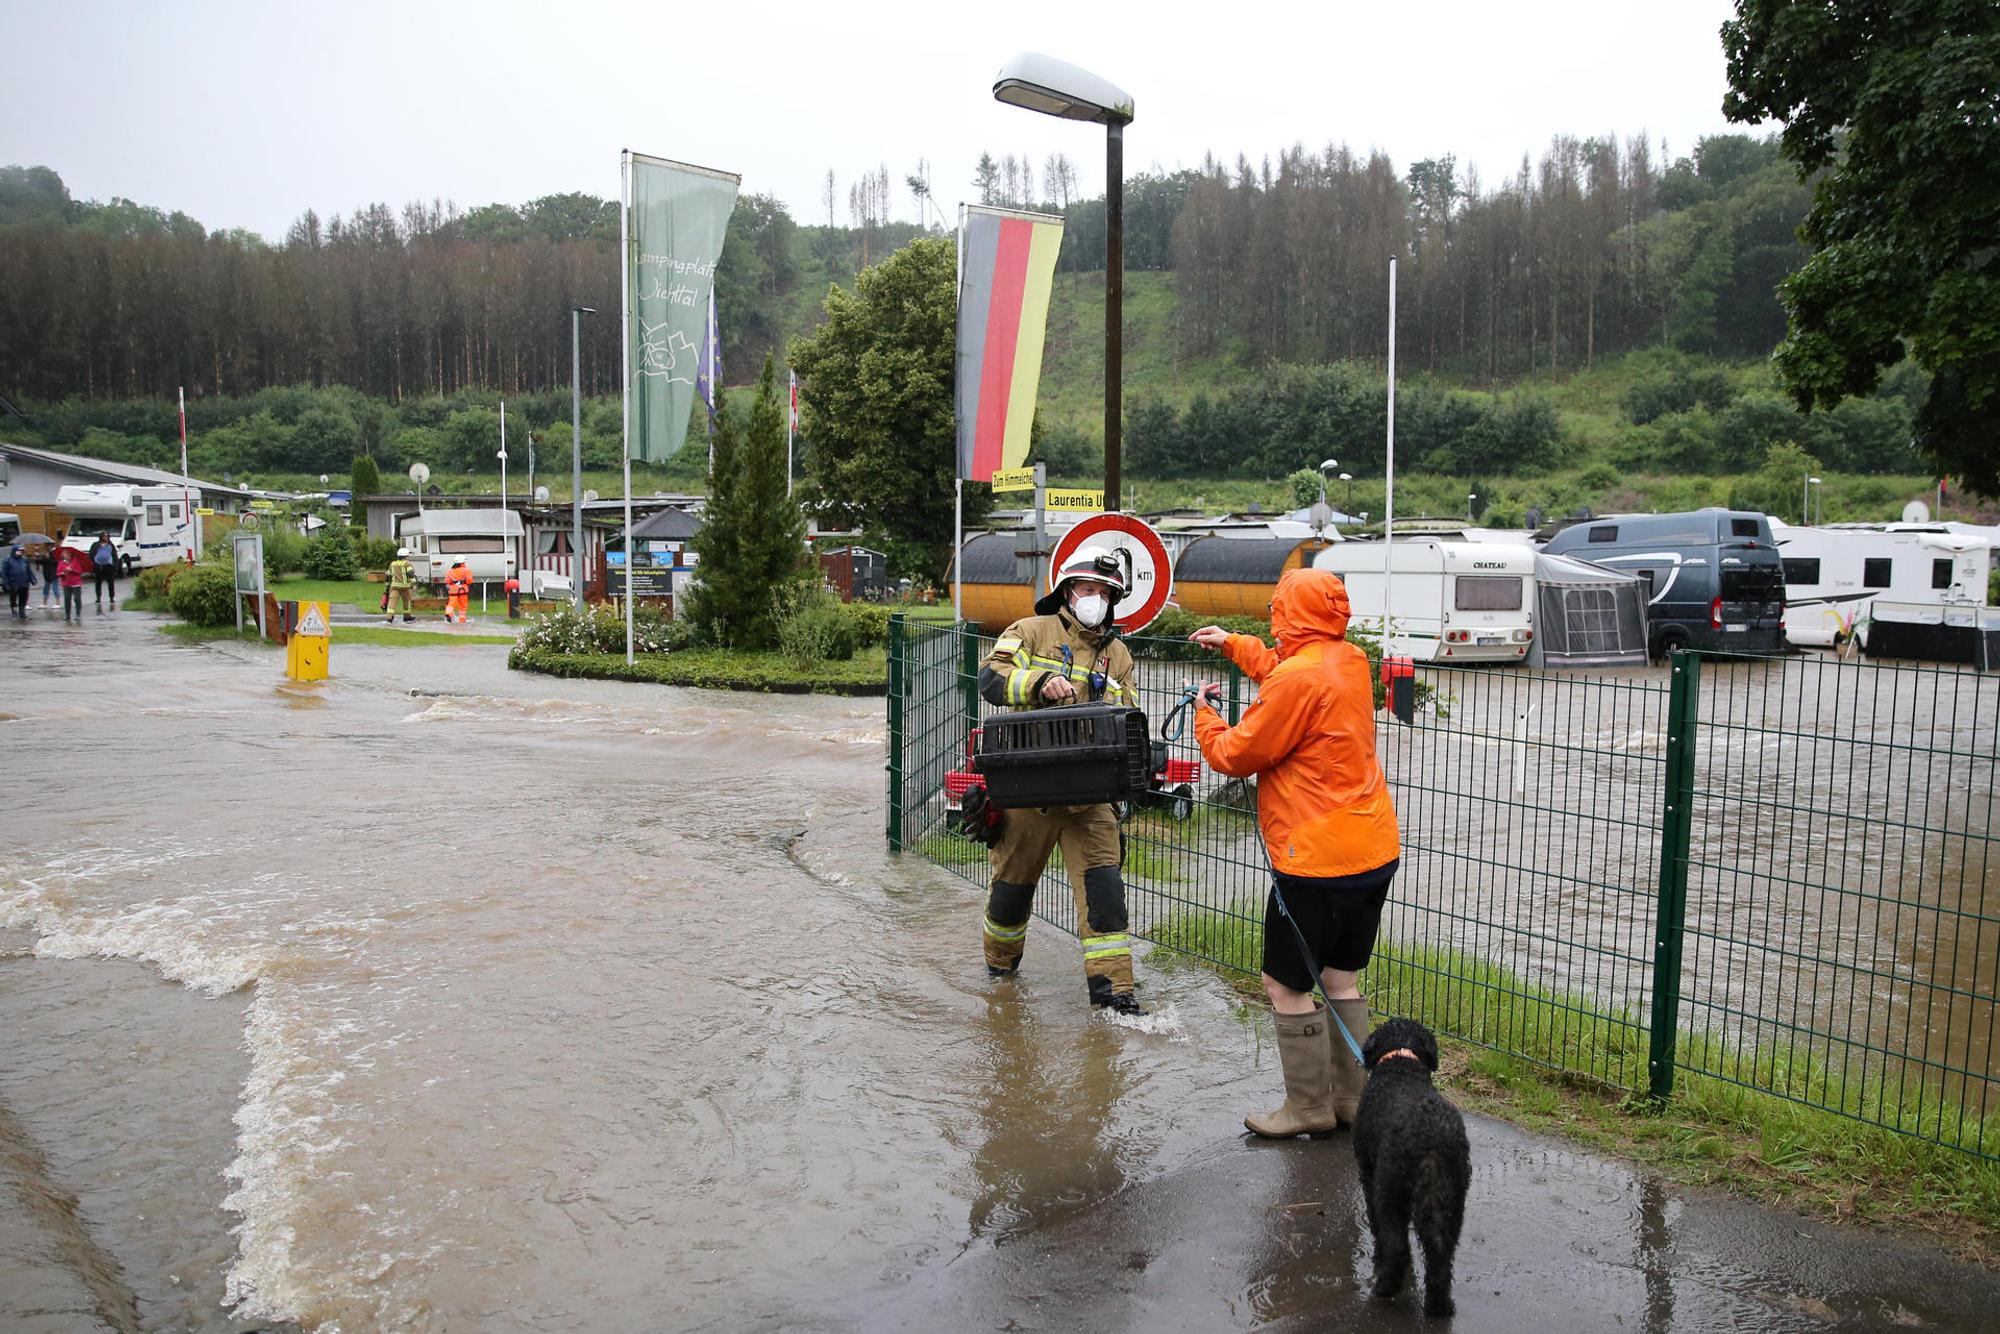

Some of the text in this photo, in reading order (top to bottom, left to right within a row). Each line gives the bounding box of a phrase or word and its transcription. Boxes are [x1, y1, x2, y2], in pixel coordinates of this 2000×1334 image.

[994, 474, 1004, 488] Zum
[1048, 493, 1105, 508] Laurentia U
[1137, 568, 1152, 581] km
